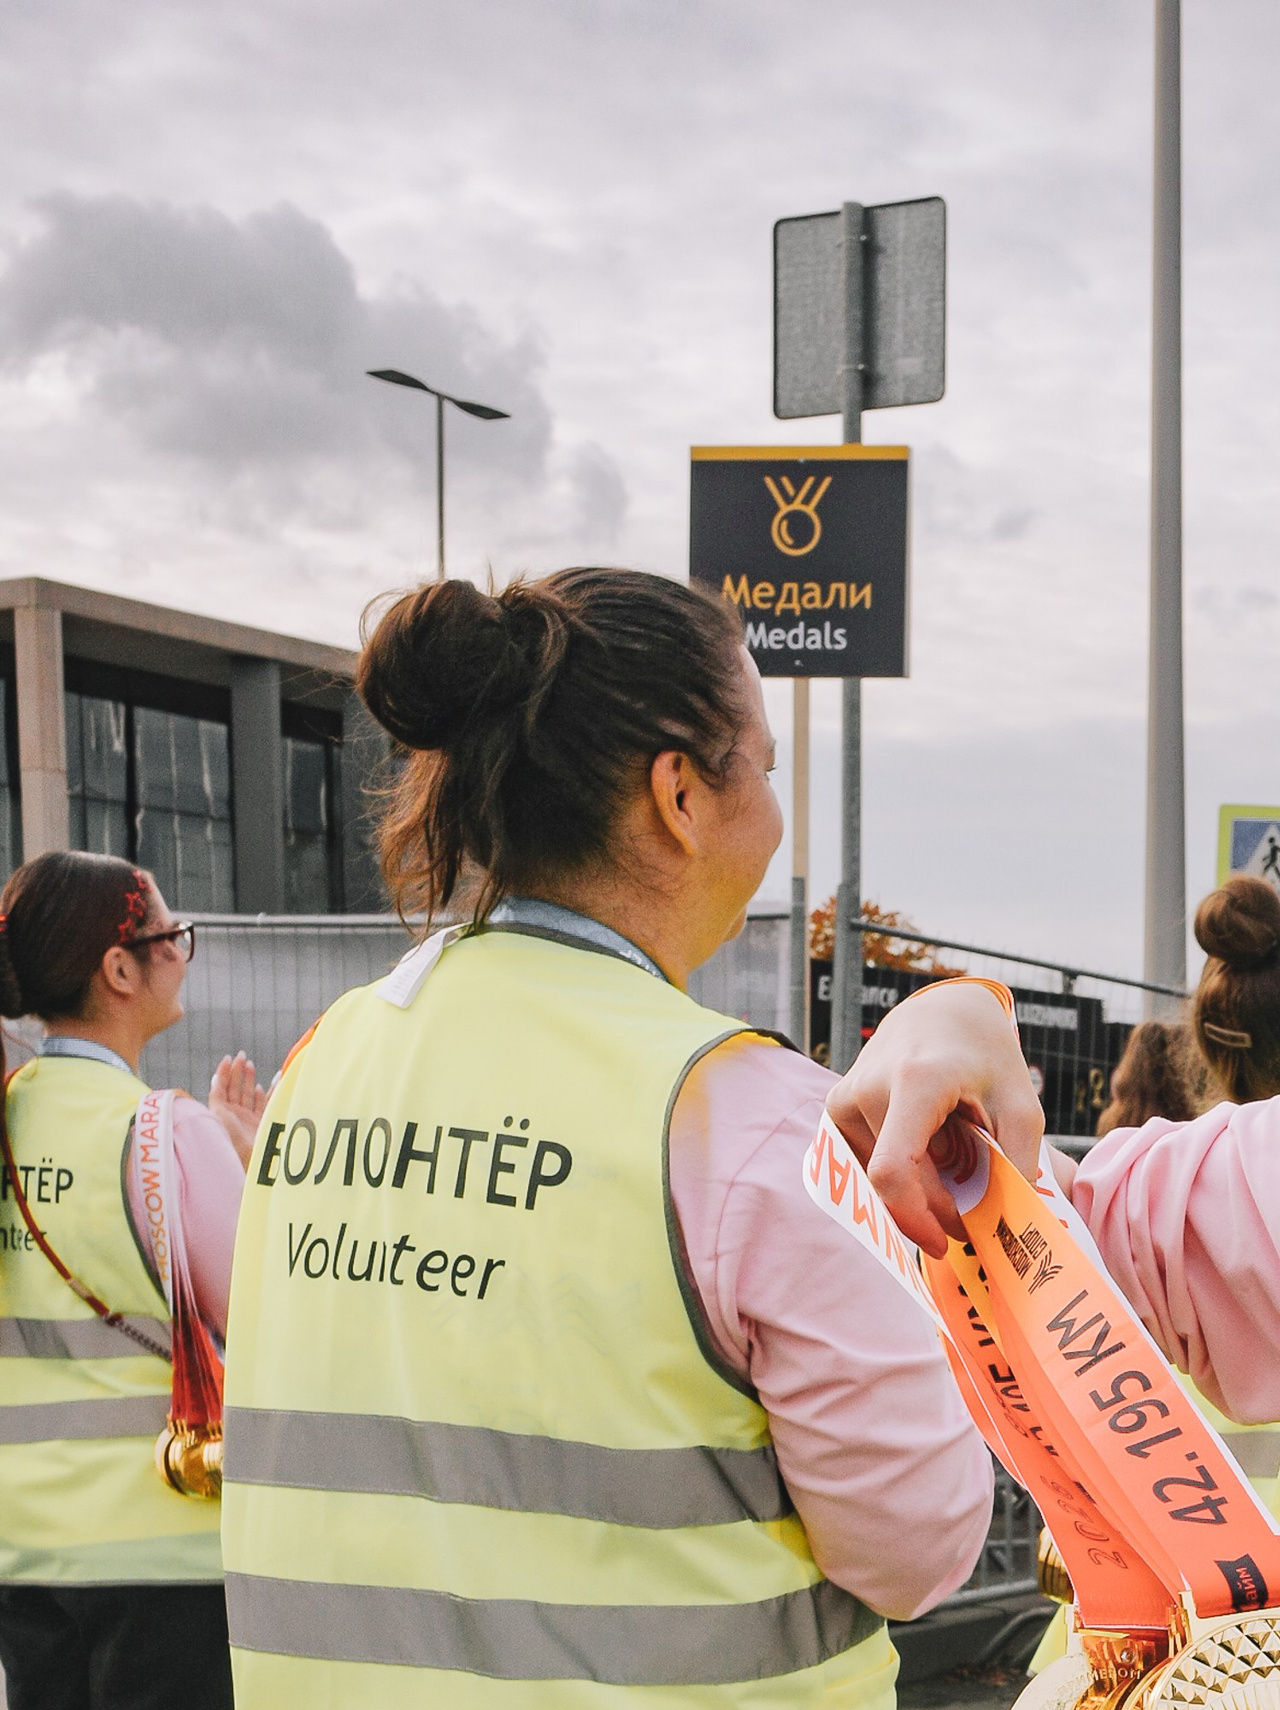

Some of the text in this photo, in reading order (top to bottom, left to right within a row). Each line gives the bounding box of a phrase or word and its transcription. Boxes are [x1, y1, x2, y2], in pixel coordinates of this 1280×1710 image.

[722, 573, 872, 616] Медали
[745, 621, 848, 650] Medals
[139, 1092, 170, 1282] MOSCOW MARA
[1018, 1222, 1049, 1261] СПОРТ
[1088, 1369, 1228, 1528] 42.195
